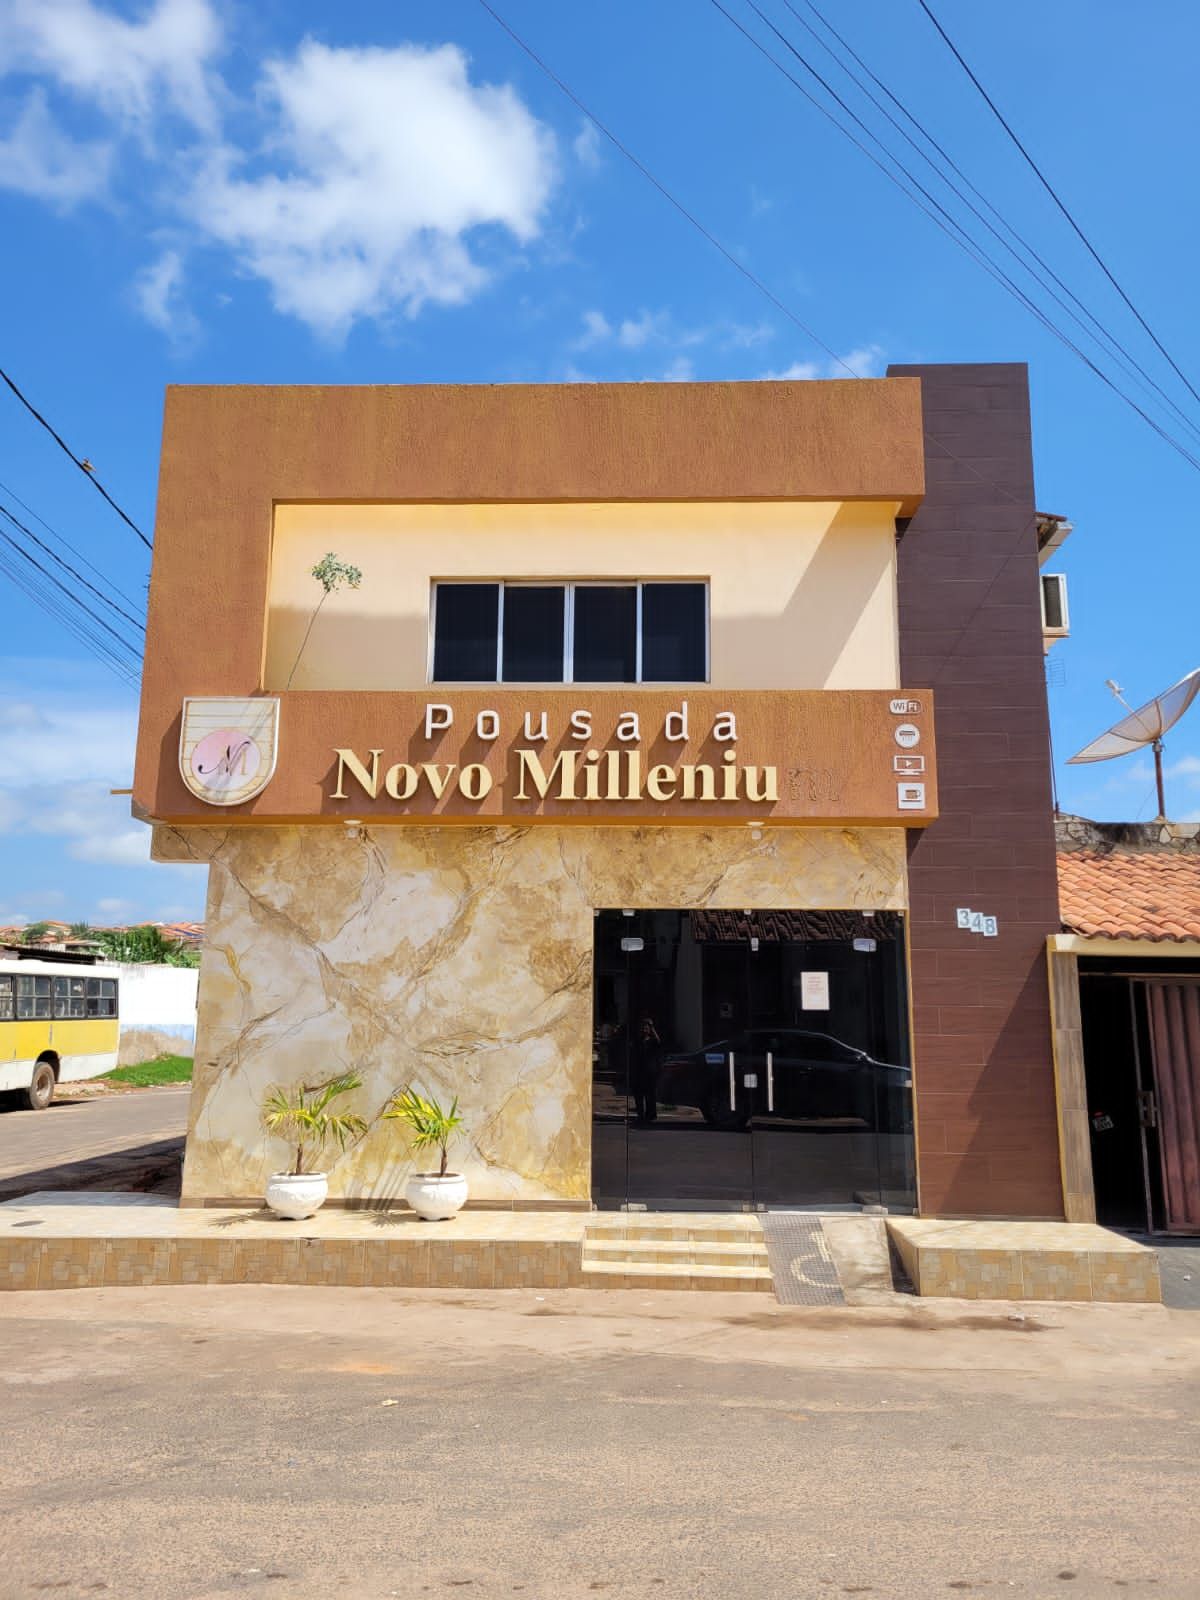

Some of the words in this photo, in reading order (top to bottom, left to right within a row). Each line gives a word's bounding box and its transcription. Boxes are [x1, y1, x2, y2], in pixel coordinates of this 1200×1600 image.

[424, 701, 738, 741] Pousada
[329, 748, 494, 800] Novo
[959, 910, 996, 934] 348
